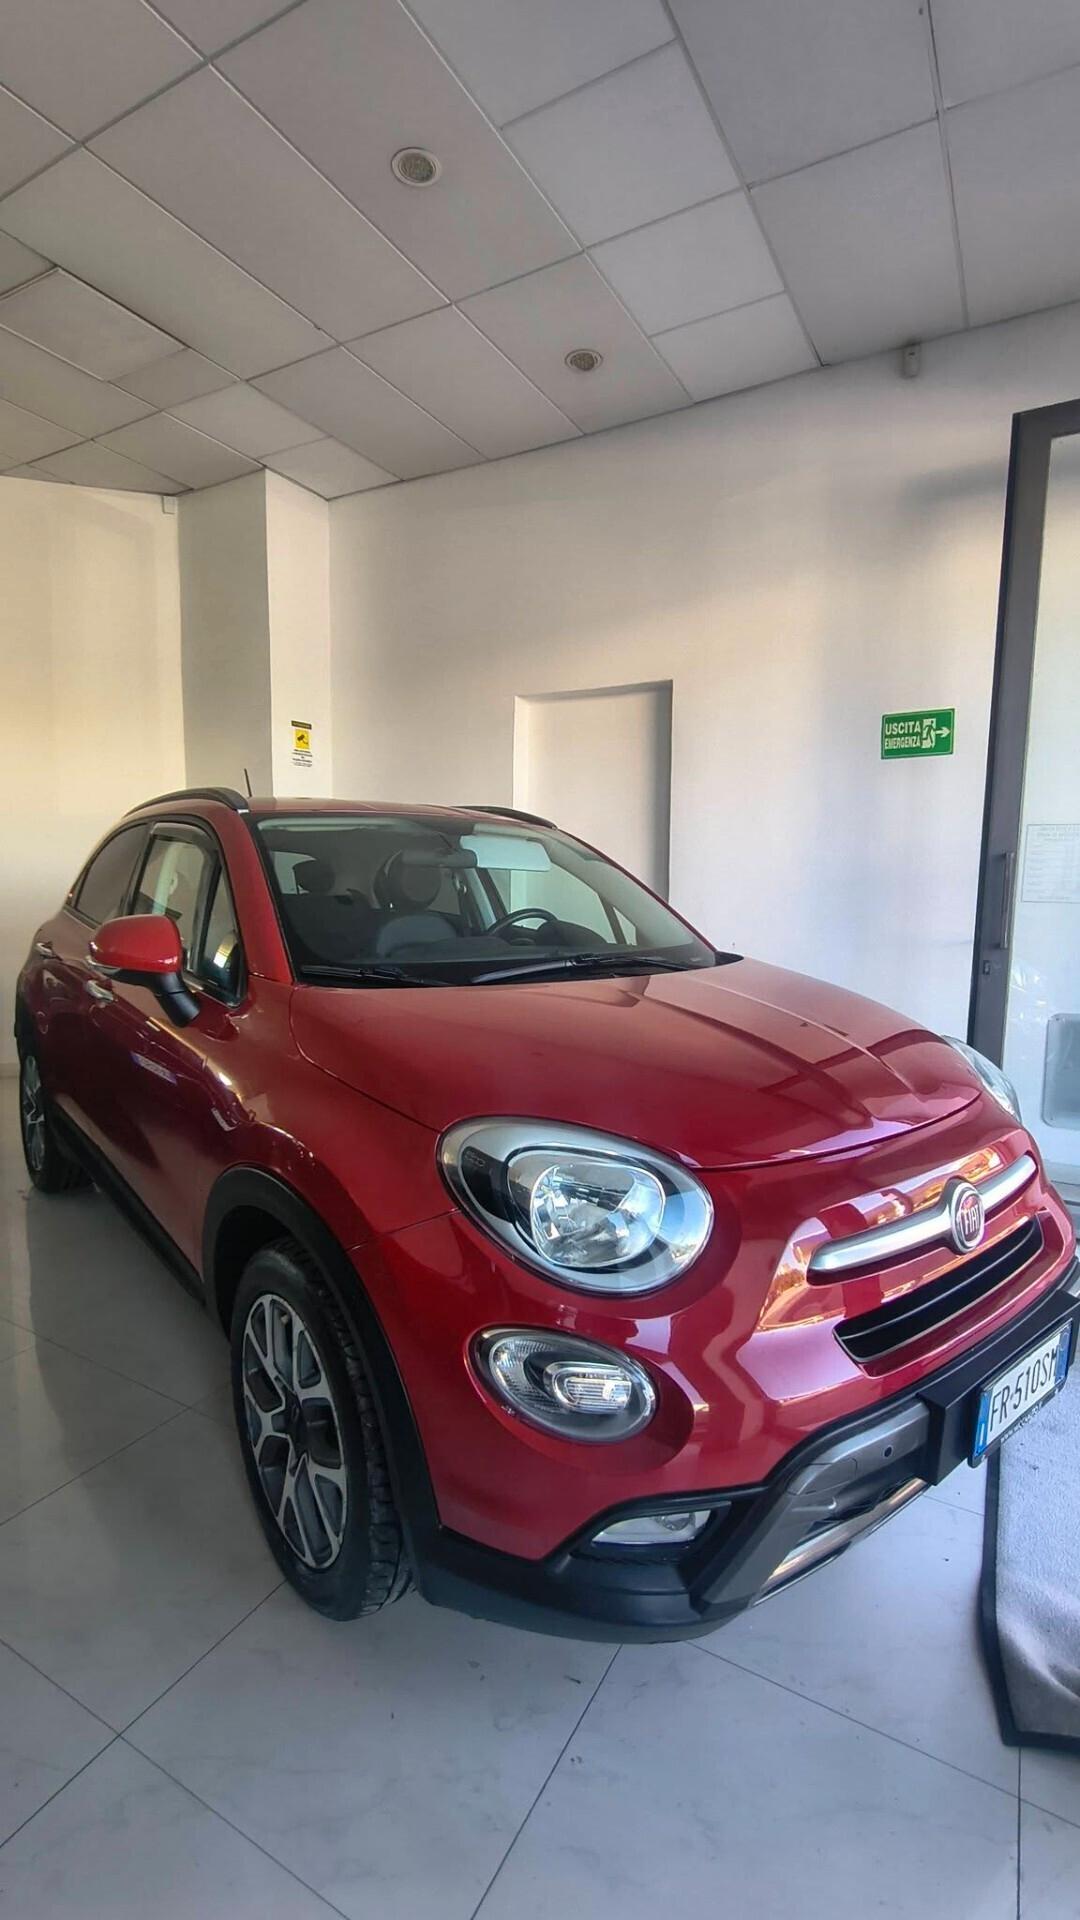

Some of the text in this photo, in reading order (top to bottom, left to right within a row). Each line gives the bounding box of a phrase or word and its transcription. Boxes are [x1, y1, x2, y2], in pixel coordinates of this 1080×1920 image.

[885, 721, 921, 735] USCITA
[885, 736, 921, 750] EMERGENZA
[963, 1204, 980, 1235] FIAT
